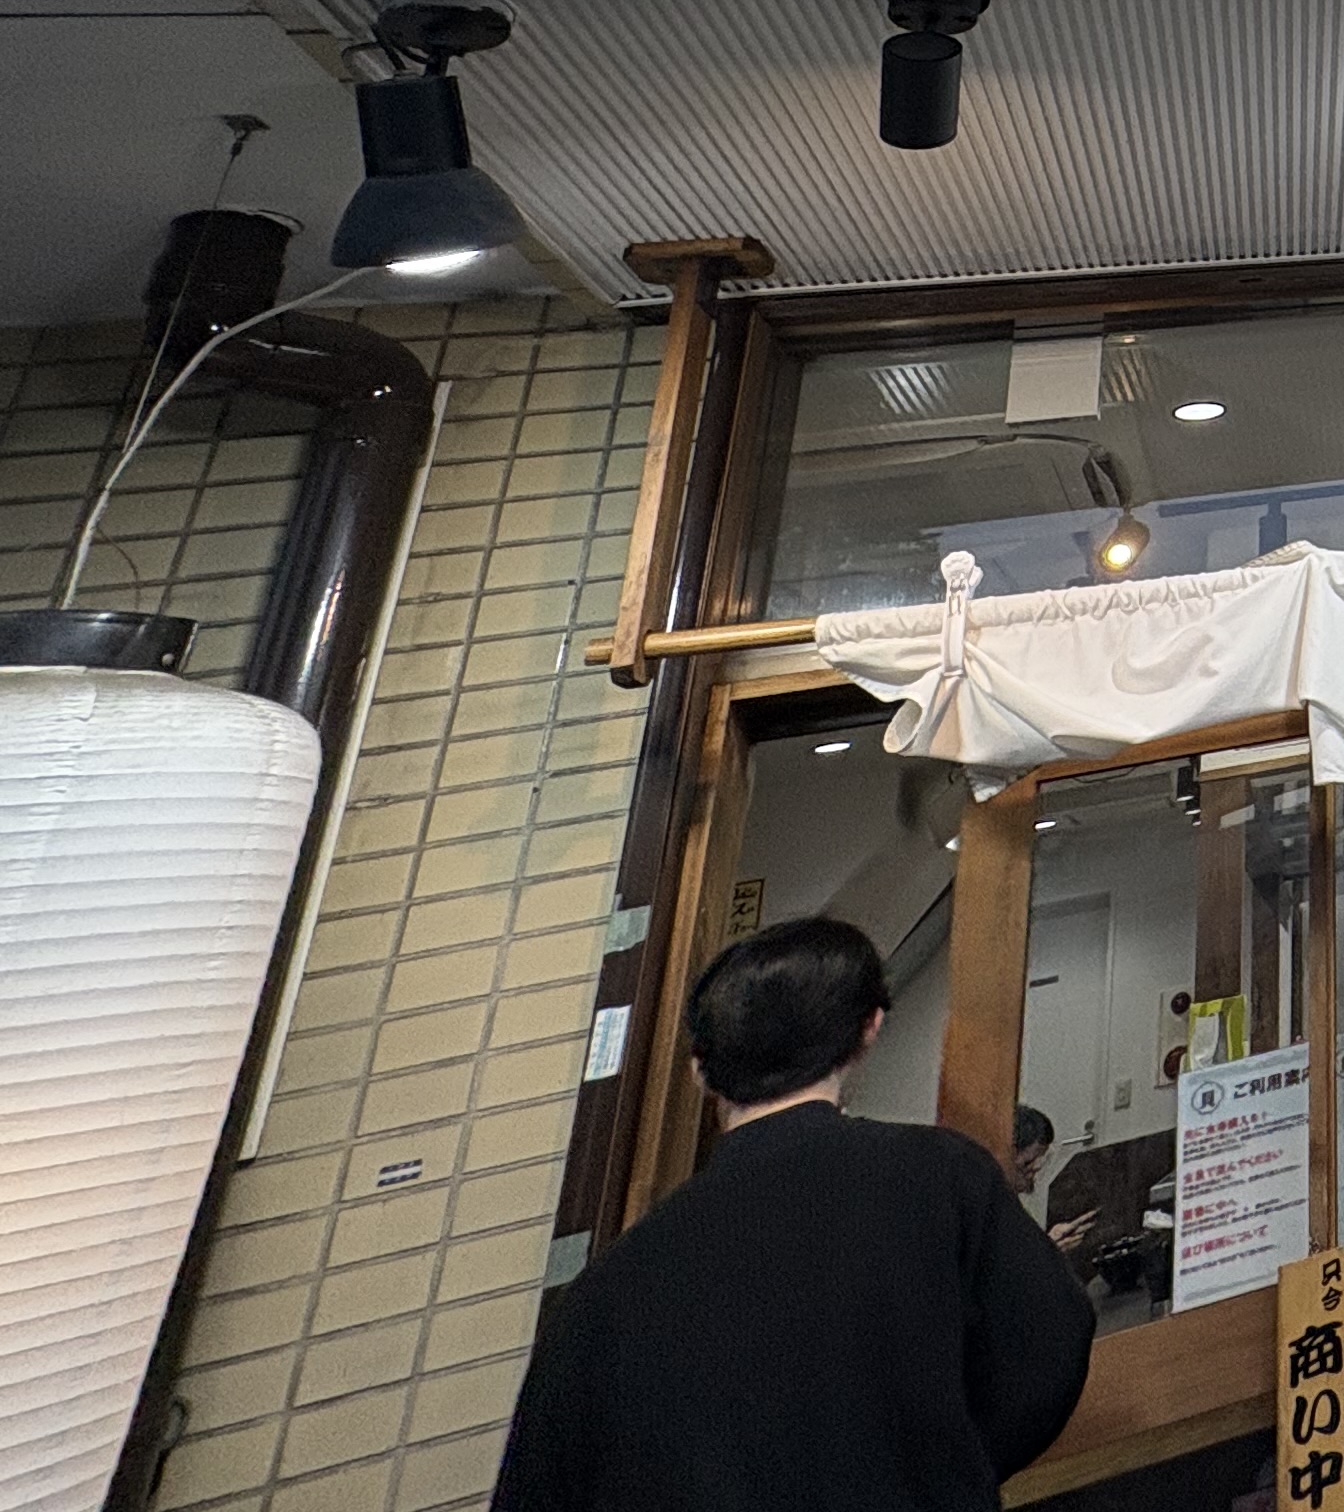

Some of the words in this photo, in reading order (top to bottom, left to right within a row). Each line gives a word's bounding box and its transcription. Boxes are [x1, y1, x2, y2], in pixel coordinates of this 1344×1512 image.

[1320, 1257, 1343, 1311] 只今
[1288, 1319, 1344, 1510] 商い中
